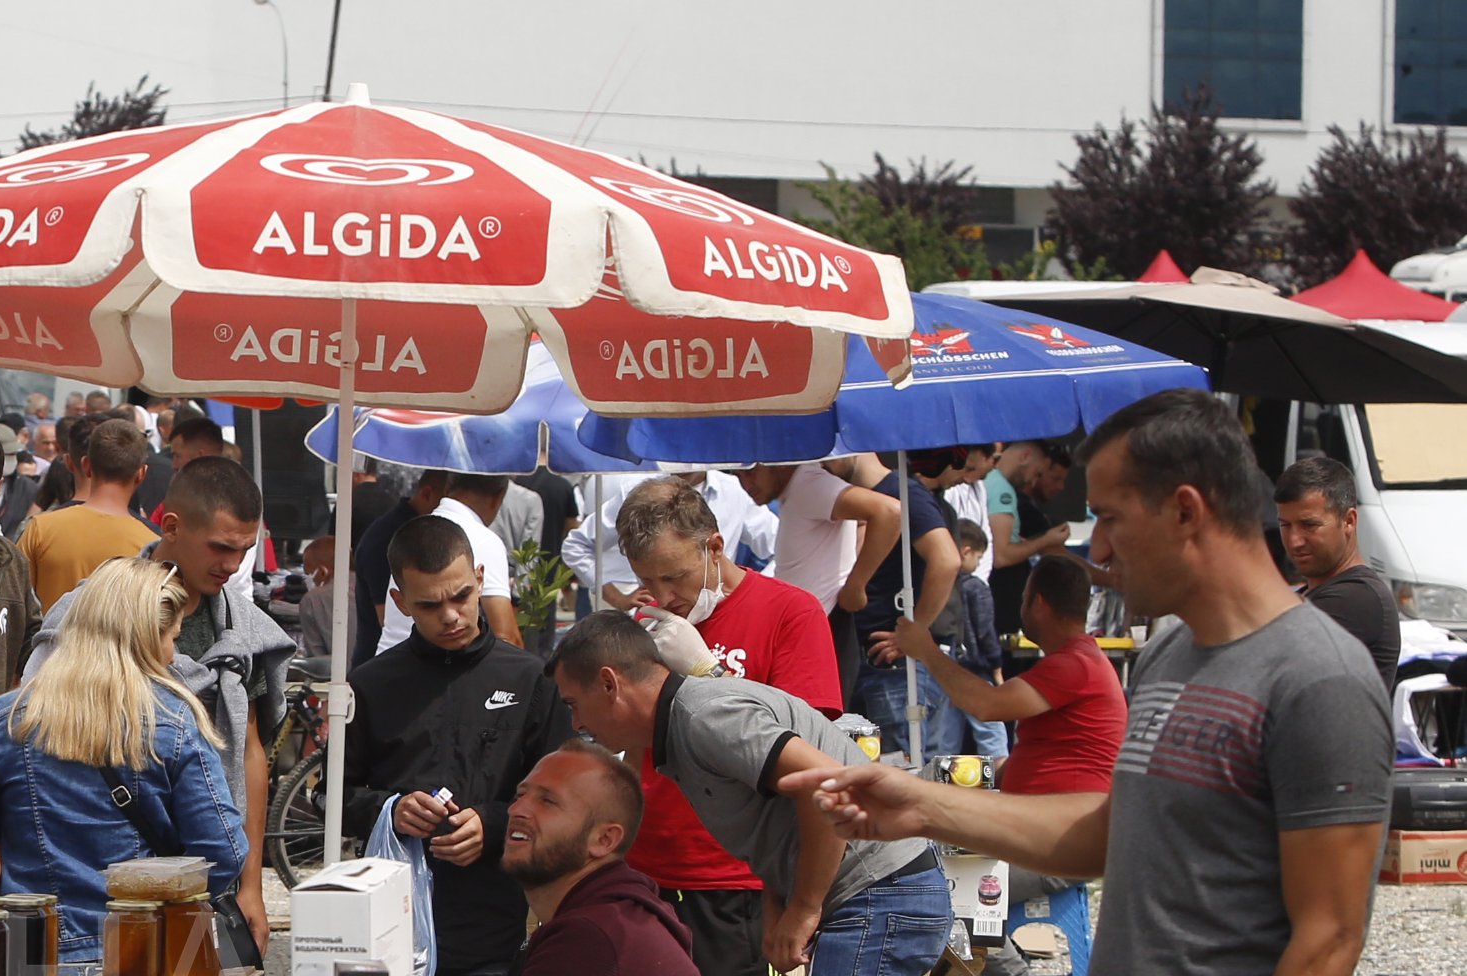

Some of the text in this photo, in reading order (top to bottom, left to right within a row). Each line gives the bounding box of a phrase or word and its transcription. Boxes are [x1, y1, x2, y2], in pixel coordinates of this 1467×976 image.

[910, 351, 1010, 365] SCHLÖSSCHEN
[491, 690, 516, 703] NIKE
[1420, 858, 1451, 873] mini
